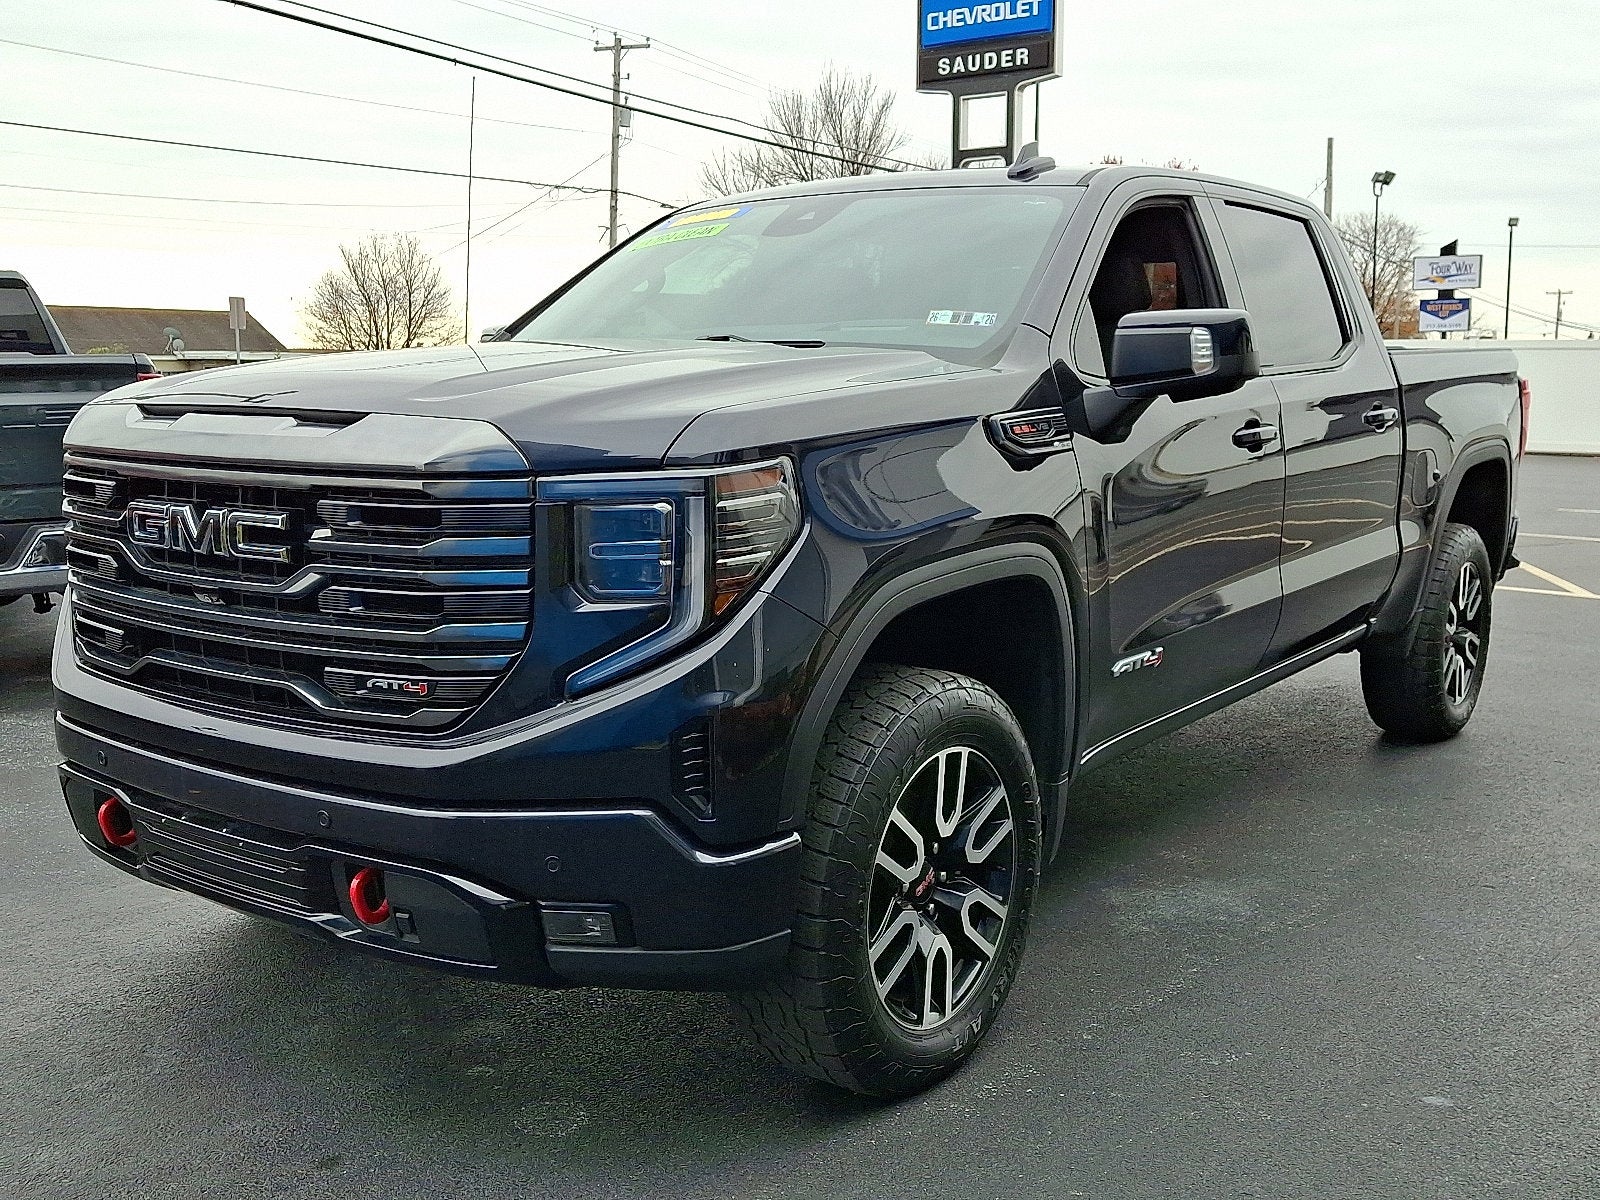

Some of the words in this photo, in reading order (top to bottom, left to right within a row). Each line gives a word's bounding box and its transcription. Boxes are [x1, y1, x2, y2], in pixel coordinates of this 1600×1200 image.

[926, 0, 1042, 31] CHEVROLET
[937, 48, 1029, 75] SAUDER
[1452, 260, 1474, 275] WAY
[984, 314, 996, 325] 26
[127, 502, 290, 563] GMC
[1110, 646, 1164, 678] AT4
[366, 678, 428, 696] AT4
